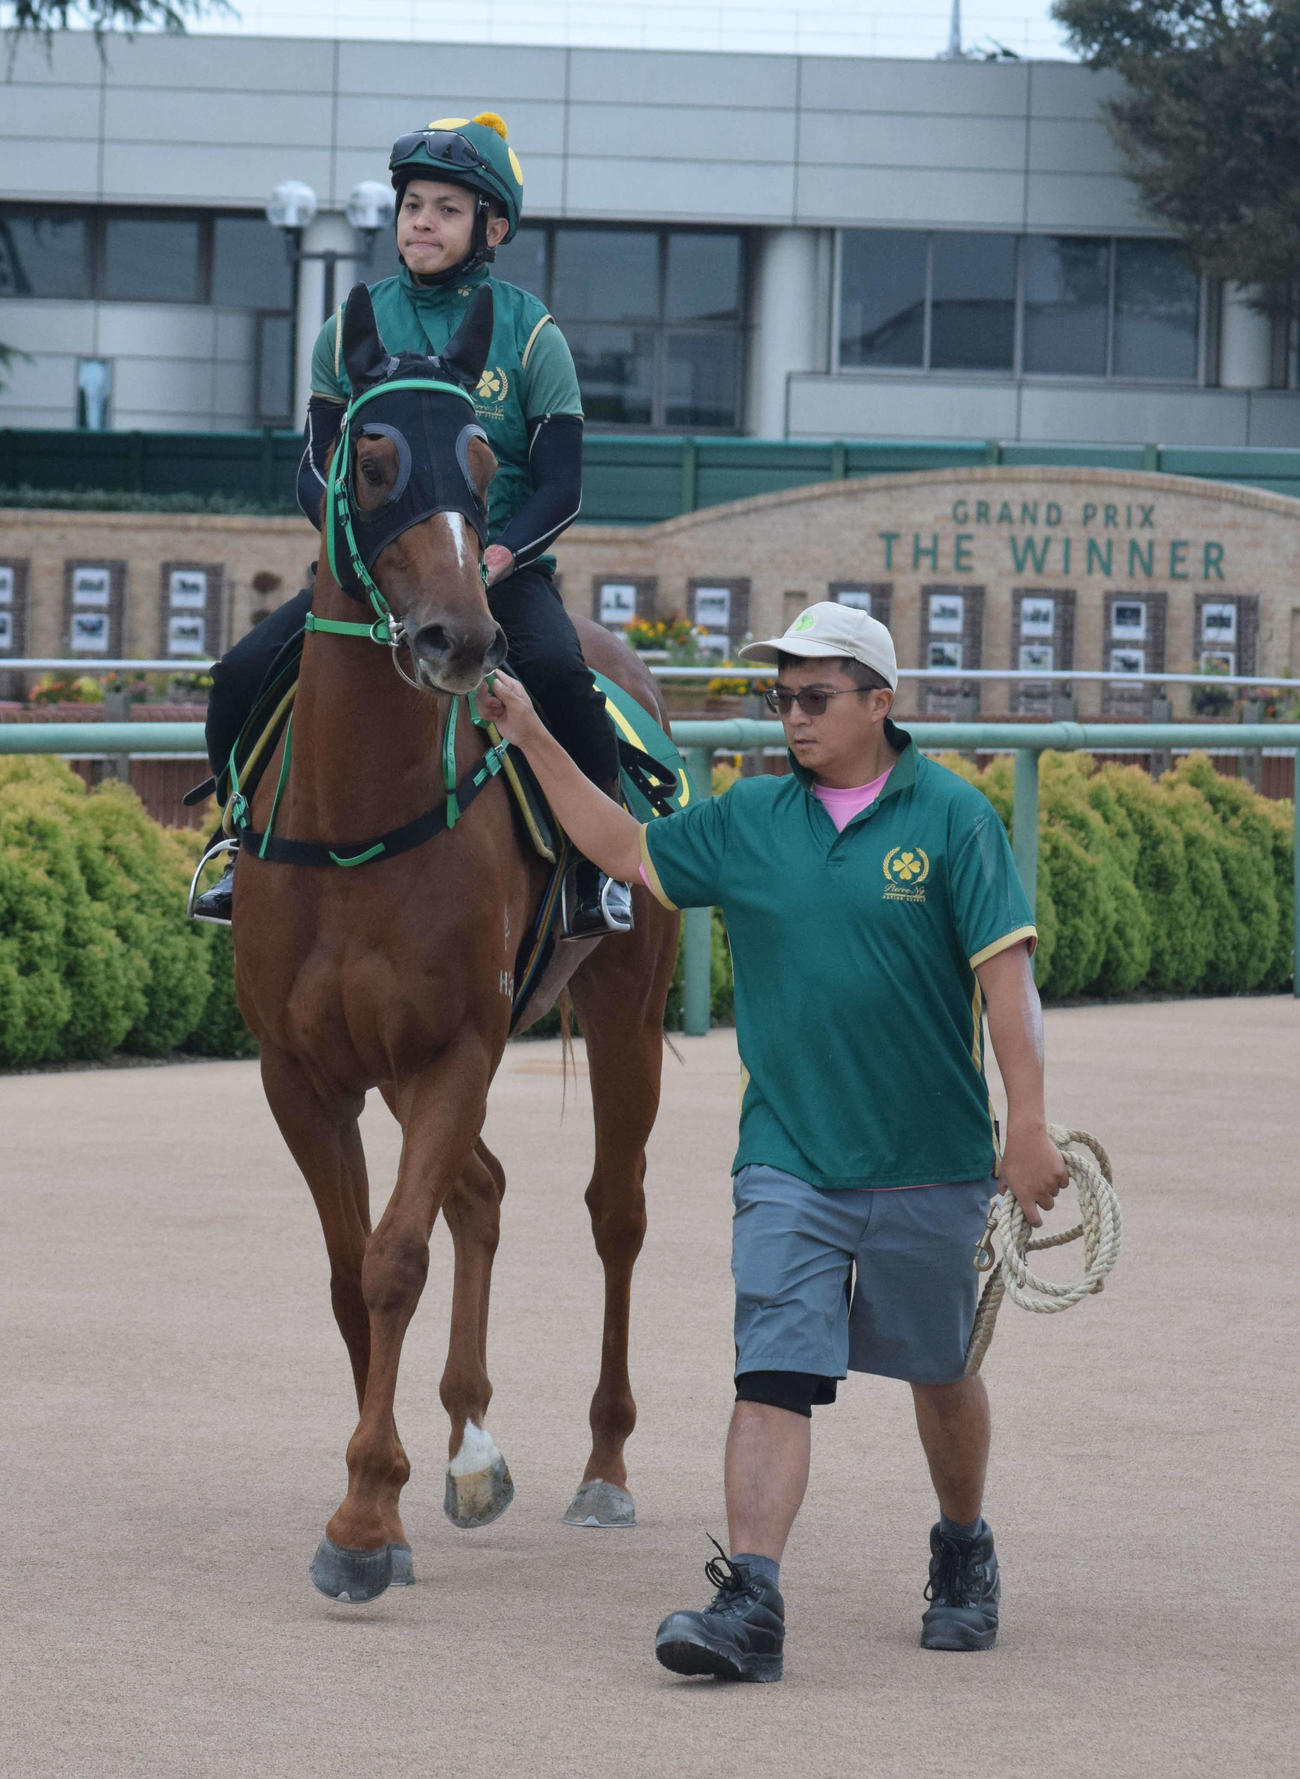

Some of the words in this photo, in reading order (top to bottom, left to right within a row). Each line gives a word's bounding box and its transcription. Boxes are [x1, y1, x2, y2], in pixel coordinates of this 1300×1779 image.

[952, 500, 1061, 527] GRAND
[1082, 504, 1155, 529] PRIX
[879, 532, 973, 572] THE
[1009, 534, 1225, 580] WINNER
